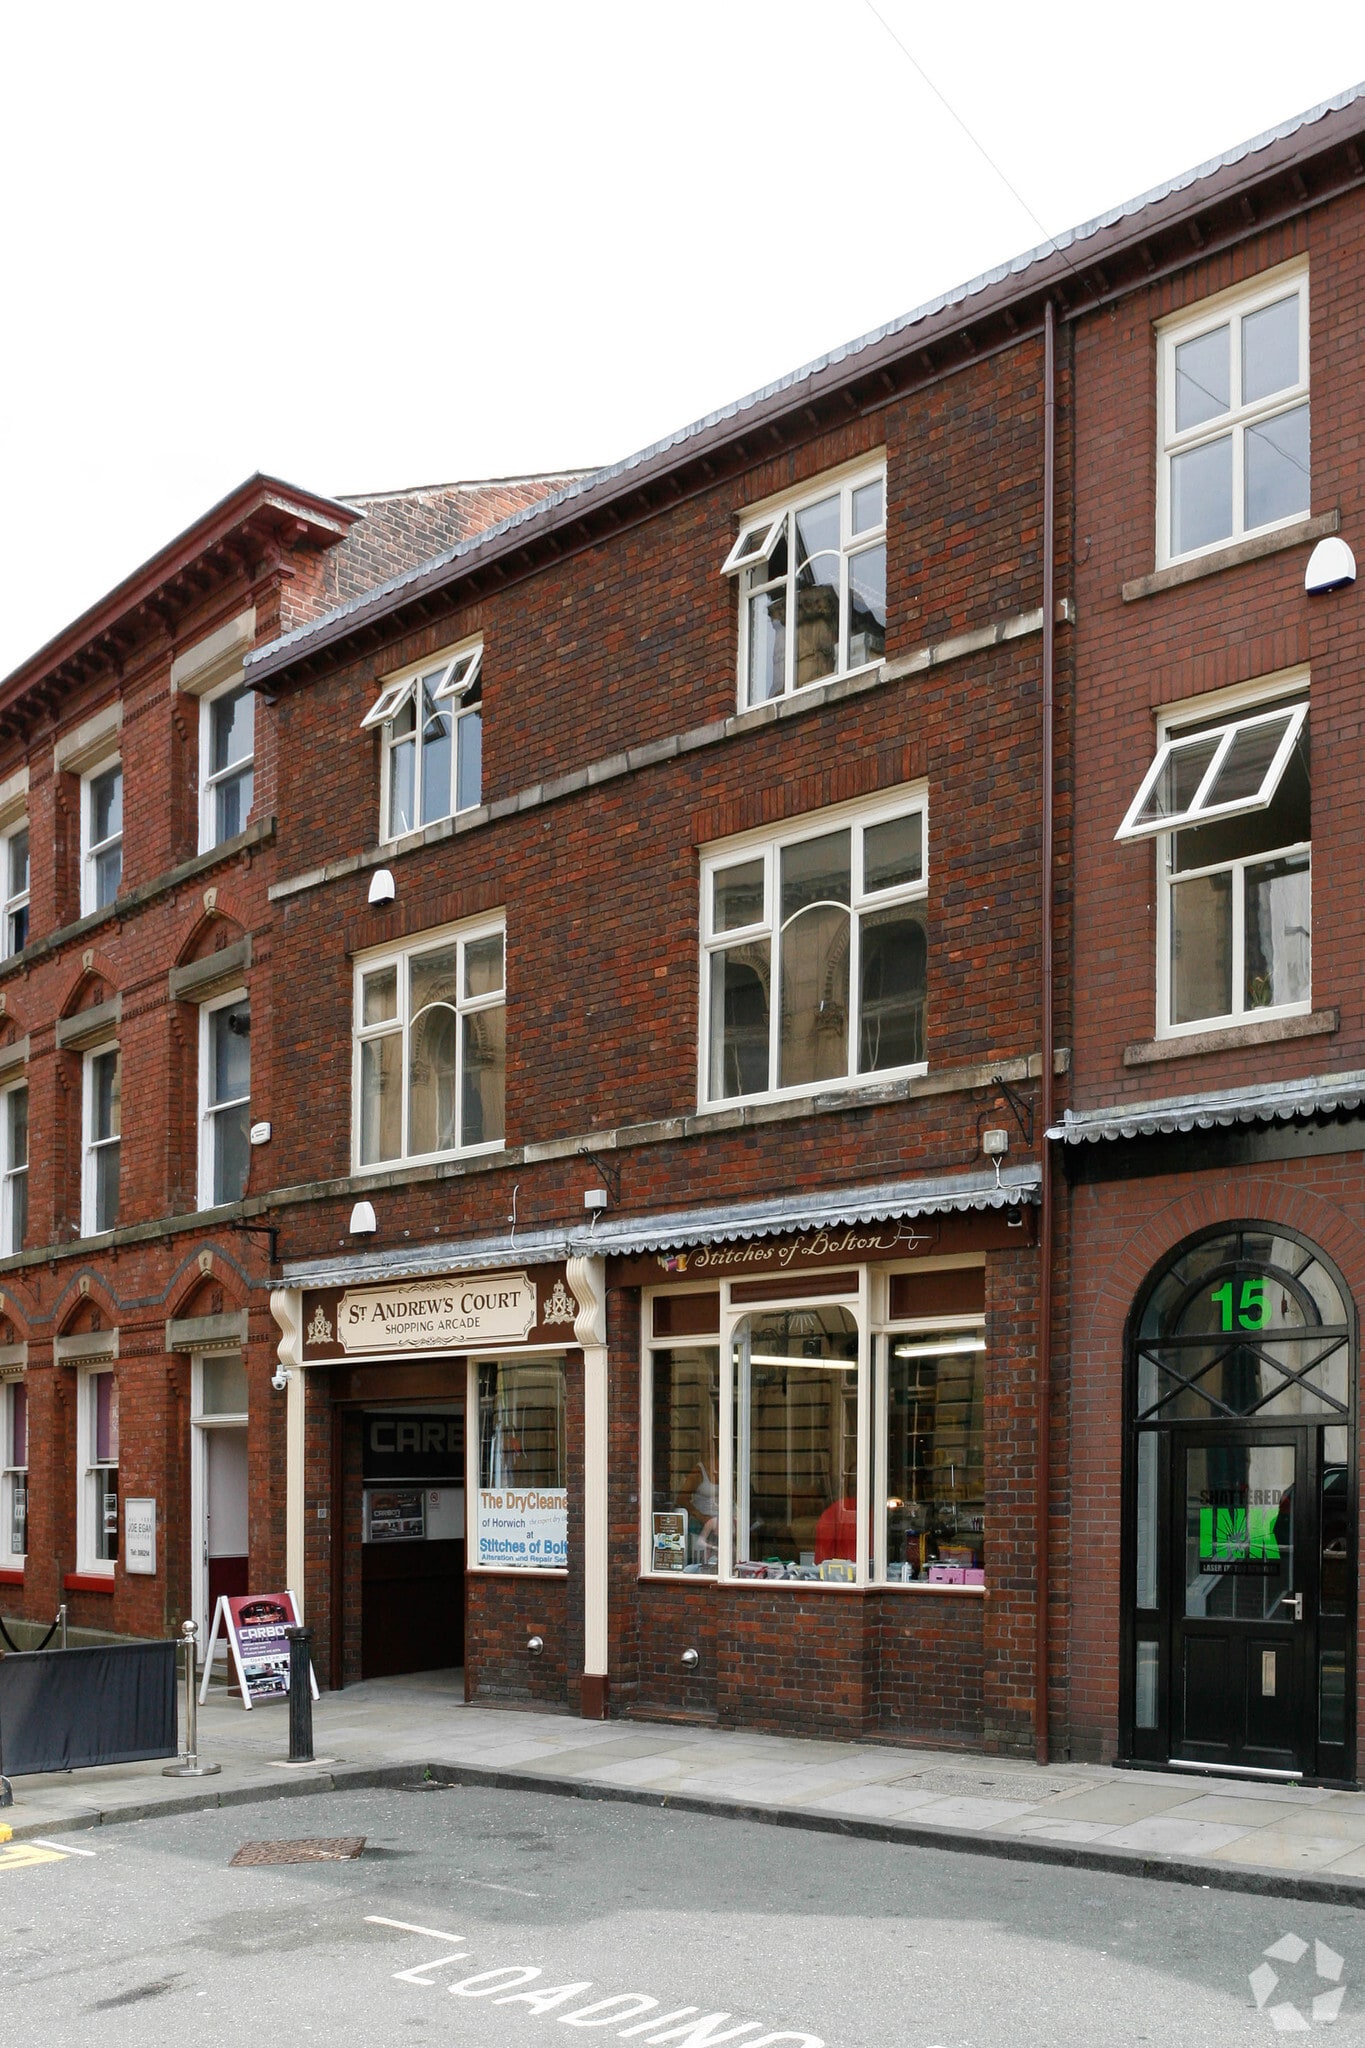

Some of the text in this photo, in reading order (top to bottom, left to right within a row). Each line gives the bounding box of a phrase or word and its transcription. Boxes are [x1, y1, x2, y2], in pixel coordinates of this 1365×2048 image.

[694, 1228, 891, 1268] Stitches of Bolton
[460, 1291, 521, 1314] COURT
[1211, 1279, 1273, 1331] 15
[385, 1316, 481, 1335] SHOPPING ARCADE
[480, 1492, 503, 1509] The
[1200, 1489, 1282, 1506] SHATTERED
[482, 1518, 526, 1528] of Horwich
[526, 1531, 534, 1539] at
[1199, 1507, 1281, 1559] INK
[479, 1538, 526, 1553] Stitches
[528, 1539, 541, 1554] of
[530, 1555, 552, 1563] Repair
[1202, 1564, 1222, 1572] LASER
